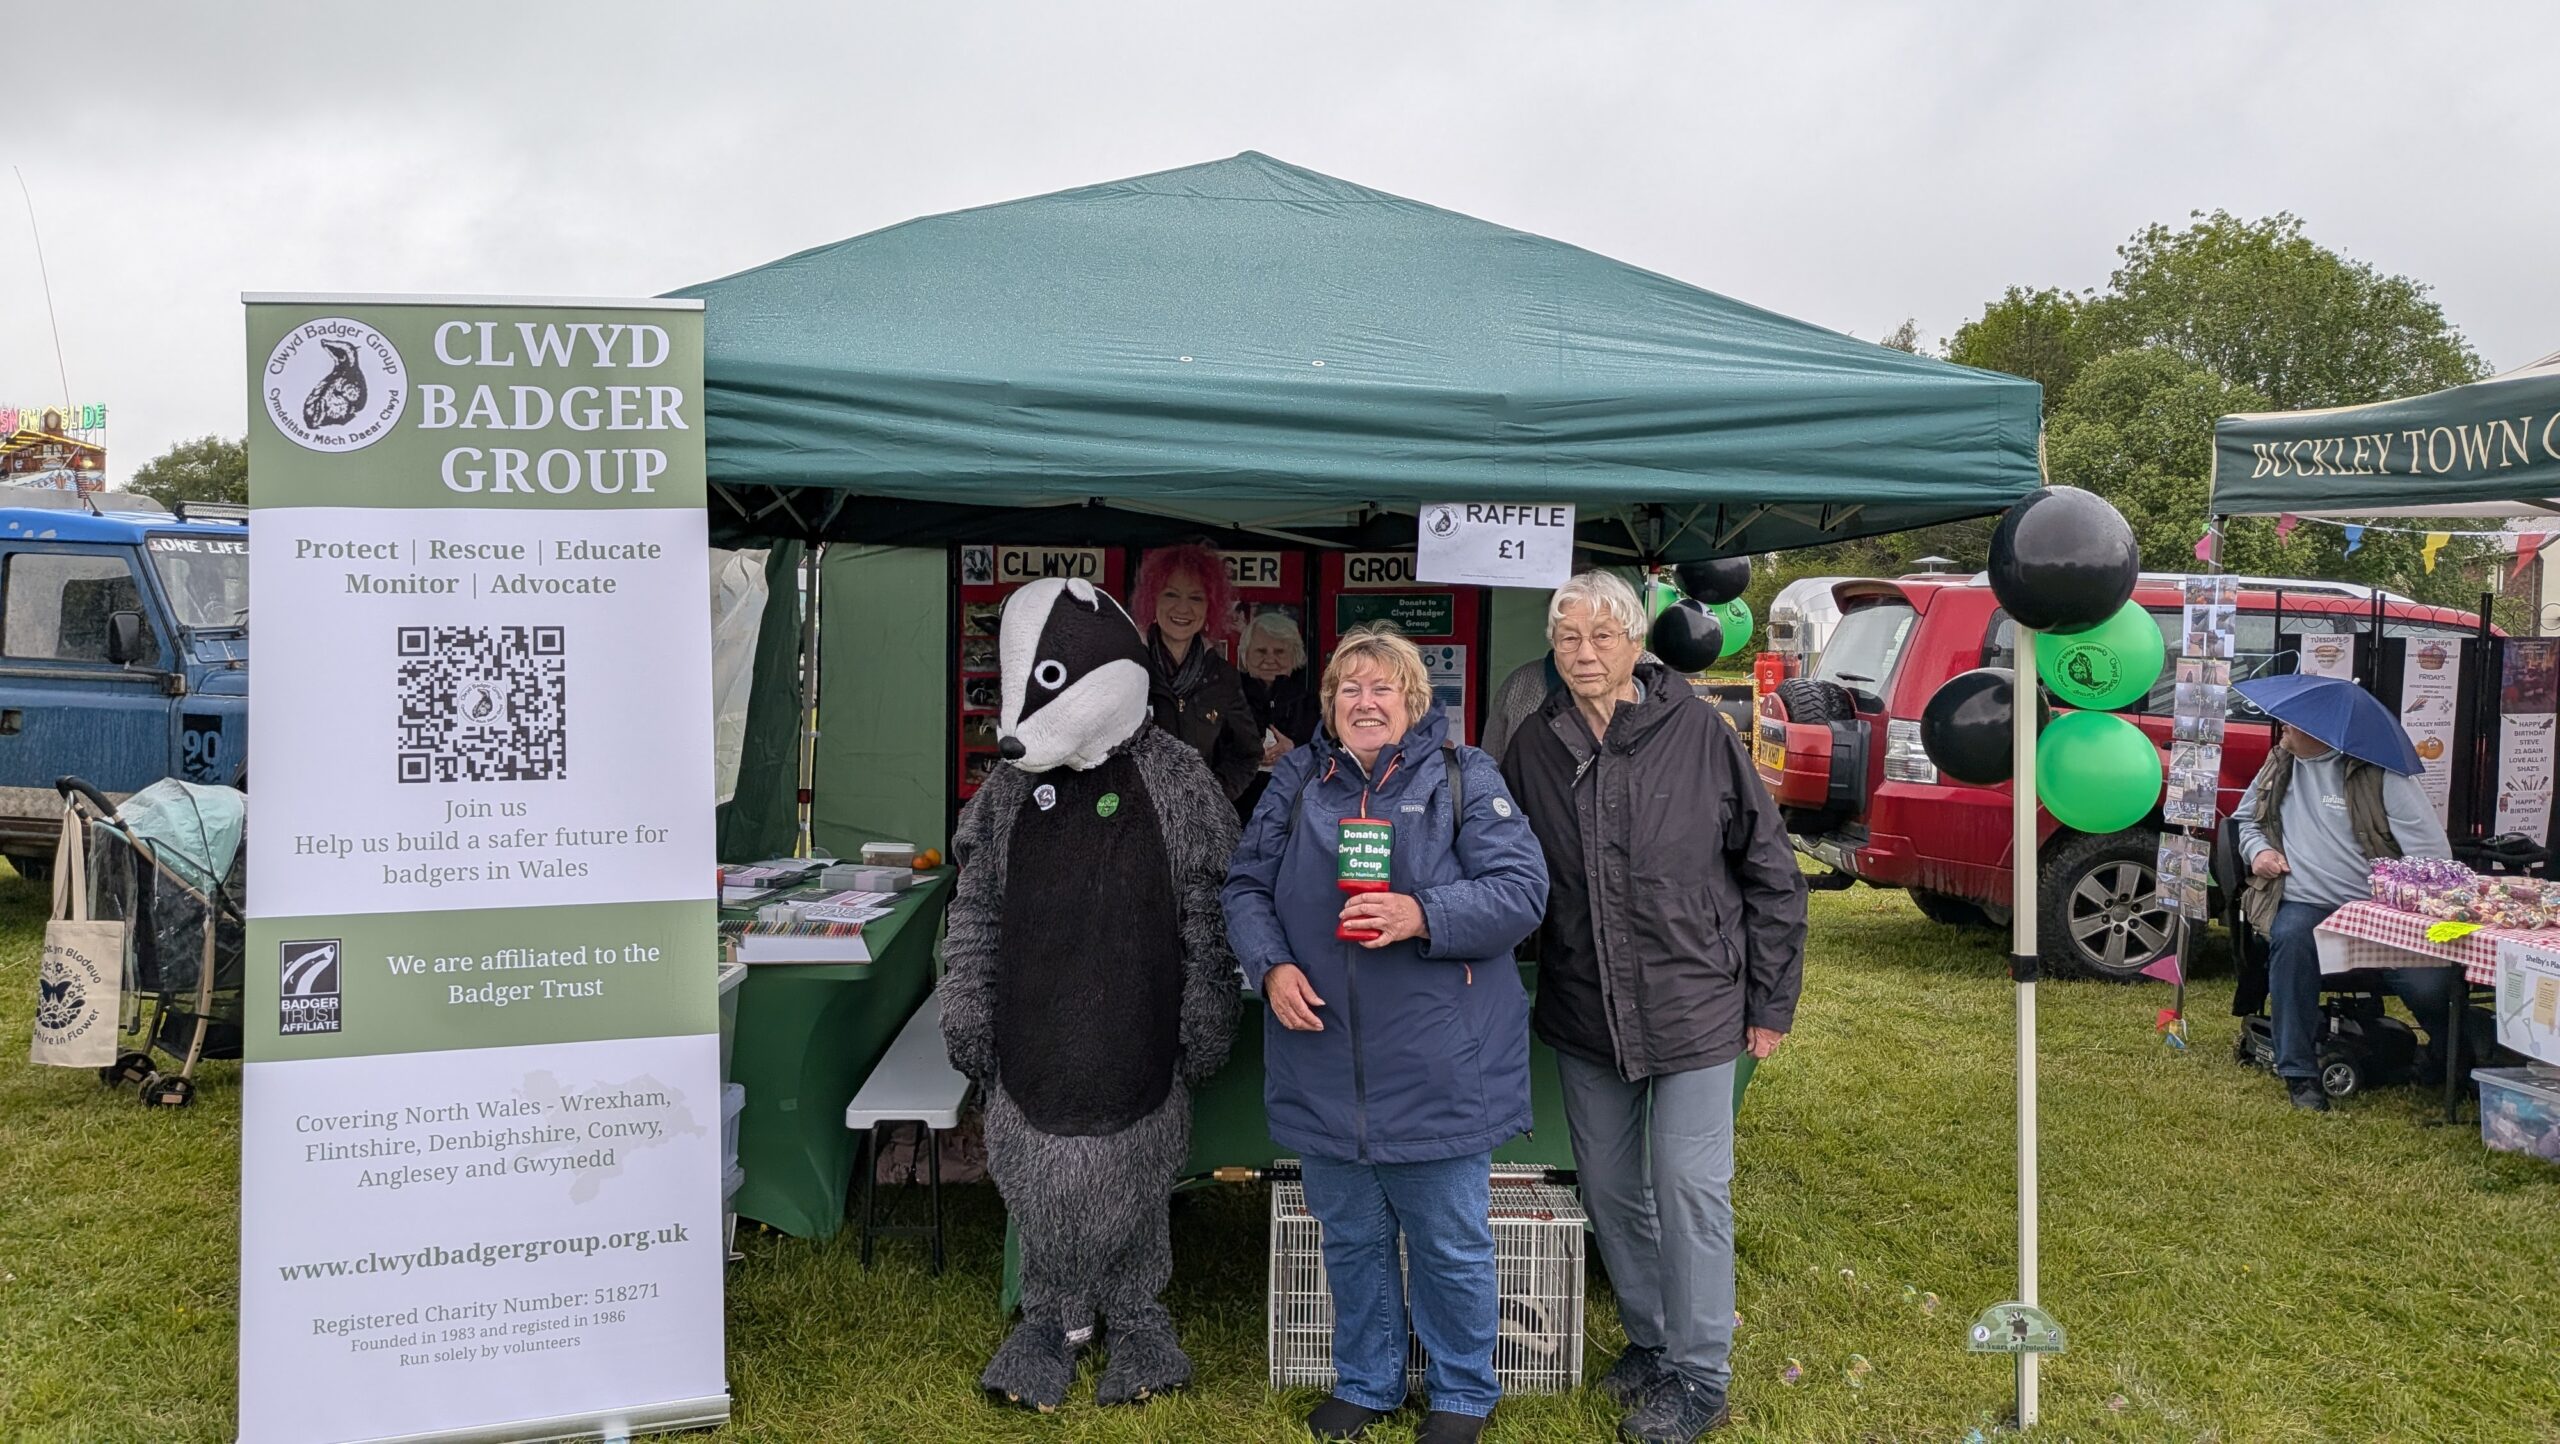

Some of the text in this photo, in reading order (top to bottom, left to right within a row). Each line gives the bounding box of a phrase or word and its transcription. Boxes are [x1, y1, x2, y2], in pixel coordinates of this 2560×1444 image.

[269, 321, 398, 375] Clwyd Badger Group
[434, 321, 670, 368] CLWYD
[313, 434, 346, 445] Môch
[349, 421, 381, 443] Daear
[380, 389, 400, 420] Clwyd
[418, 384, 689, 430] BADGER
[2252, 433, 2393, 478] BUCKLEY
[2402, 417, 2532, 473] TOWN
[441, 447, 667, 494] GROUP
[1466, 504, 1565, 527] RAFFLE
[160, 538, 202, 553] ONE
[295, 539, 399, 560] Protect
[429, 540, 525, 560] Rescue
[555, 540, 662, 560] Educate
[1499, 539, 1525, 560] £1
[1003, 551, 1097, 578] CLWYD
[1349, 557, 1417, 582] GROU
[345, 573, 459, 594] Monitor
[490, 573, 617, 594] Advocate
[1391, 609, 1445, 618] Clwyd Badger
[1406, 620, 1430, 628] Group
[183, 730, 222, 766] 90
[444, 800, 527, 823] Join us
[294, 824, 669, 858] Help us build a safer future for
[1344, 830, 1389, 840] Donate to
[383, 859, 588, 887] badgers in Wales
[1349, 858, 1382, 871] Group
[65, 947, 102, 984] Blodeuo
[386, 944, 660, 976] We are affiliated to the
[2525, 954, 2549, 967] Shelby's
[281, 997, 338, 1010] BADGER
[448, 978, 603, 1007] Badger Trust
[67, 1009, 100, 1042] Flower
[281, 1020, 339, 1033] AFFILIATE
[282, 1007, 336, 1023] TRUST
[296, 1109, 398, 1135] Covering
[405, 1102, 470, 1126] North
[476, 1098, 541, 1120] Wales
[561, 1090, 672, 1114] Wrexham,
[305, 1118, 663, 1163] Flintshire, Denbighshire, Conwy,
[357, 1148, 615, 1190] Anglesey and Gwynedd
[278, 1223, 689, 1281] www.clwydbadgergroup.org.uk
[312, 1282, 659, 1336] Registered Charity Number: 518271
[351, 1310, 626, 1352] Founded in 1983 and registed in 1986
[400, 1333, 581, 1366] Run solely by volunteers
